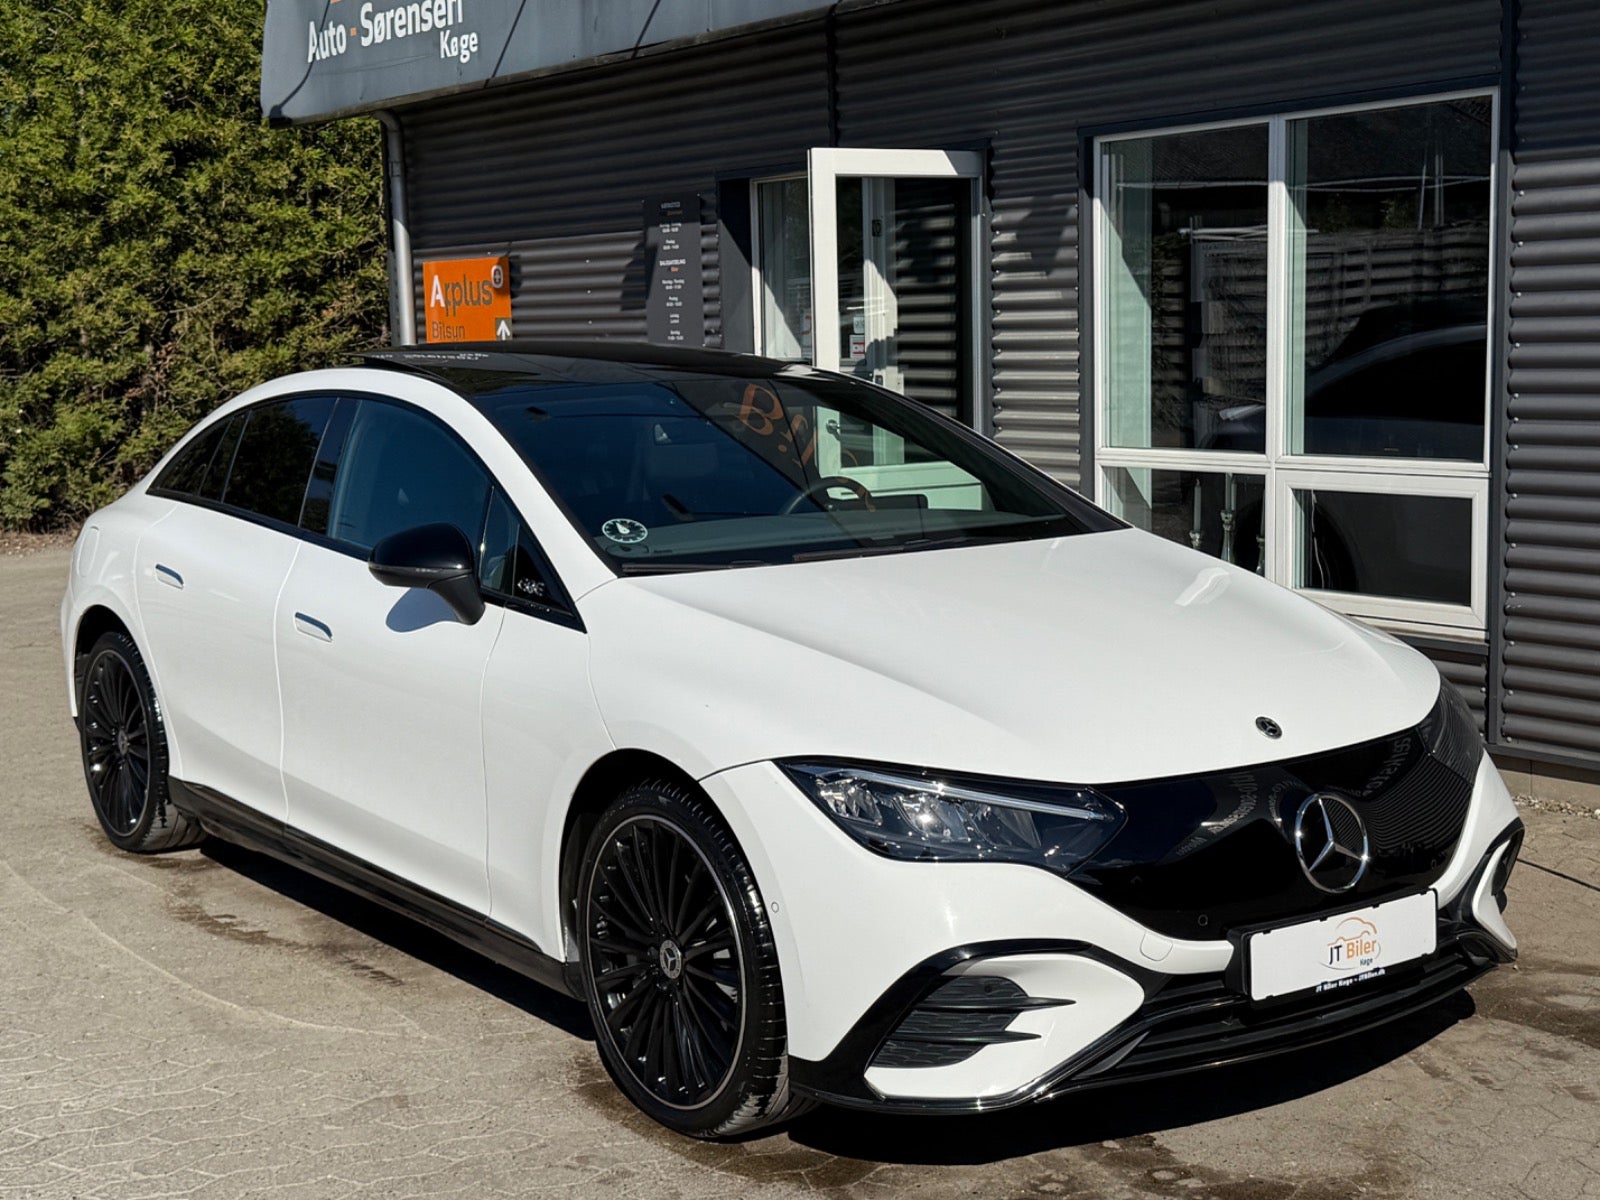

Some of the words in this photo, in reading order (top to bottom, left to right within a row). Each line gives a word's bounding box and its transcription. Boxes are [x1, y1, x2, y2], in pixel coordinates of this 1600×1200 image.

[307, 21, 347, 63] Auto
[360, 0, 463, 47] Sørensen
[440, 31, 478, 63] Køge
[1346, 939, 1377, 959] Biler
